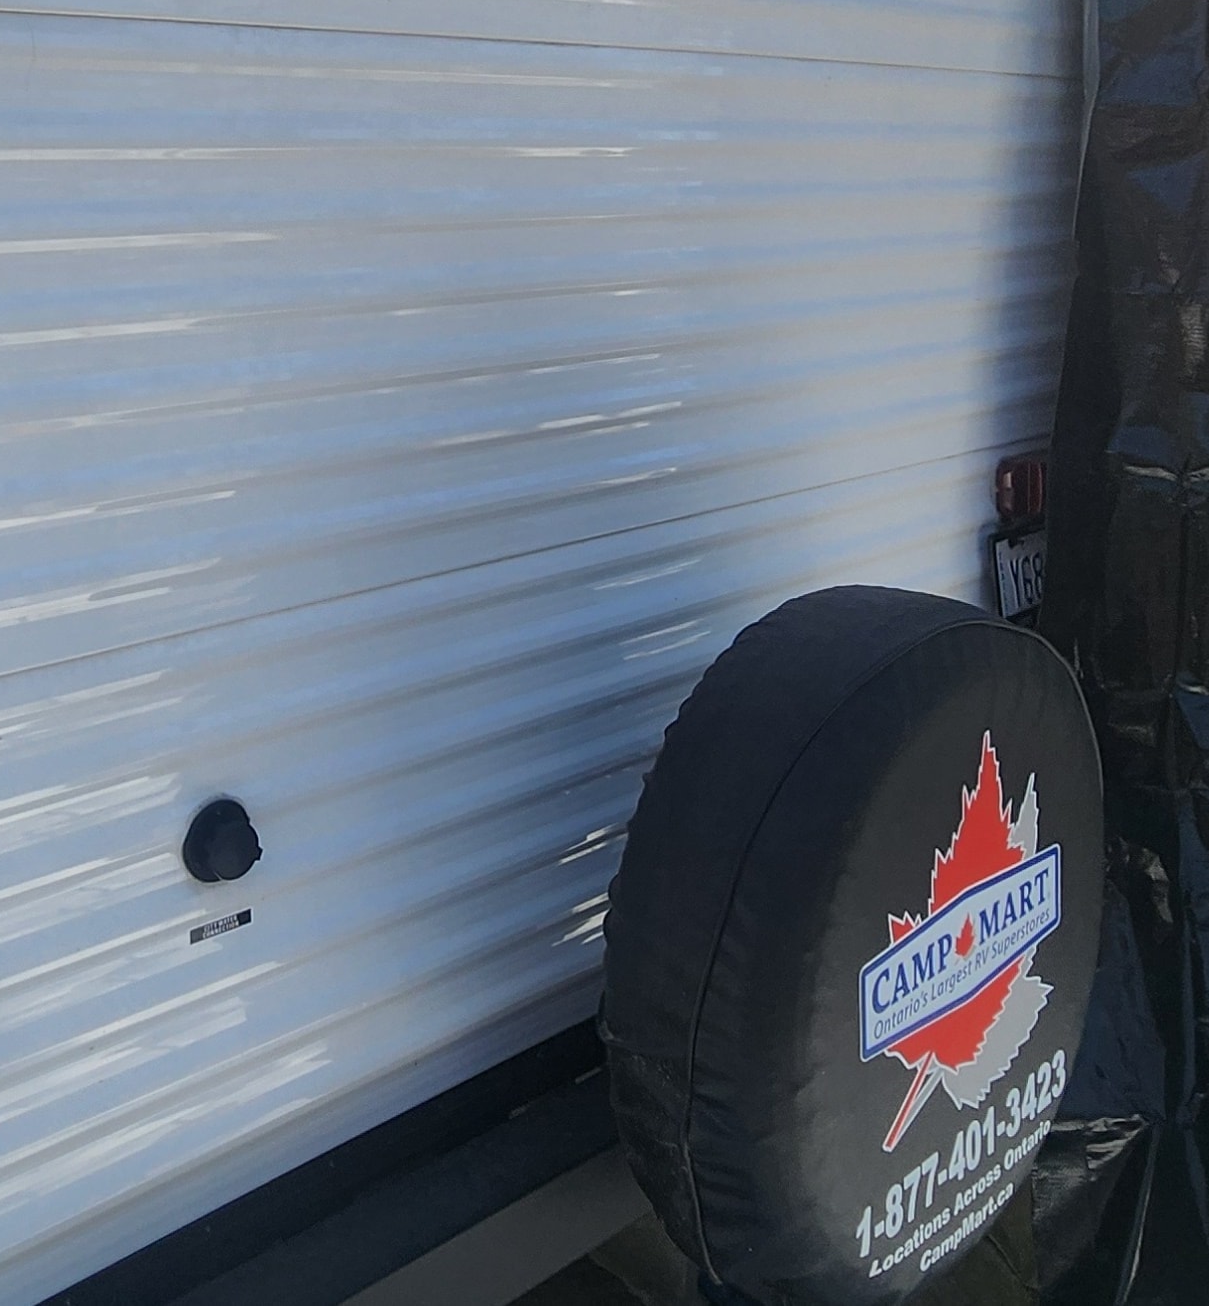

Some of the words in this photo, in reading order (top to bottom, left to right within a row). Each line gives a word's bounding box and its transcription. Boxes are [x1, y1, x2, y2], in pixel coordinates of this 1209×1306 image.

[871, 933, 953, 1015] CAMP
[978, 866, 1050, 946] MART
[873, 990, 928, 1040] Ontario's
[930, 959, 972, 1002] Largest
[975, 945, 990, 971] RV
[991, 908, 1050, 960] Superstores
[855, 1049, 1067, 1259] 1-877-401-3423
[868, 1206, 951, 1279] Locations
[953, 1164, 1002, 1217] Across
[1003, 1120, 1051, 1171] Ontario
[919, 1182, 1015, 1273] CampMart.ca
